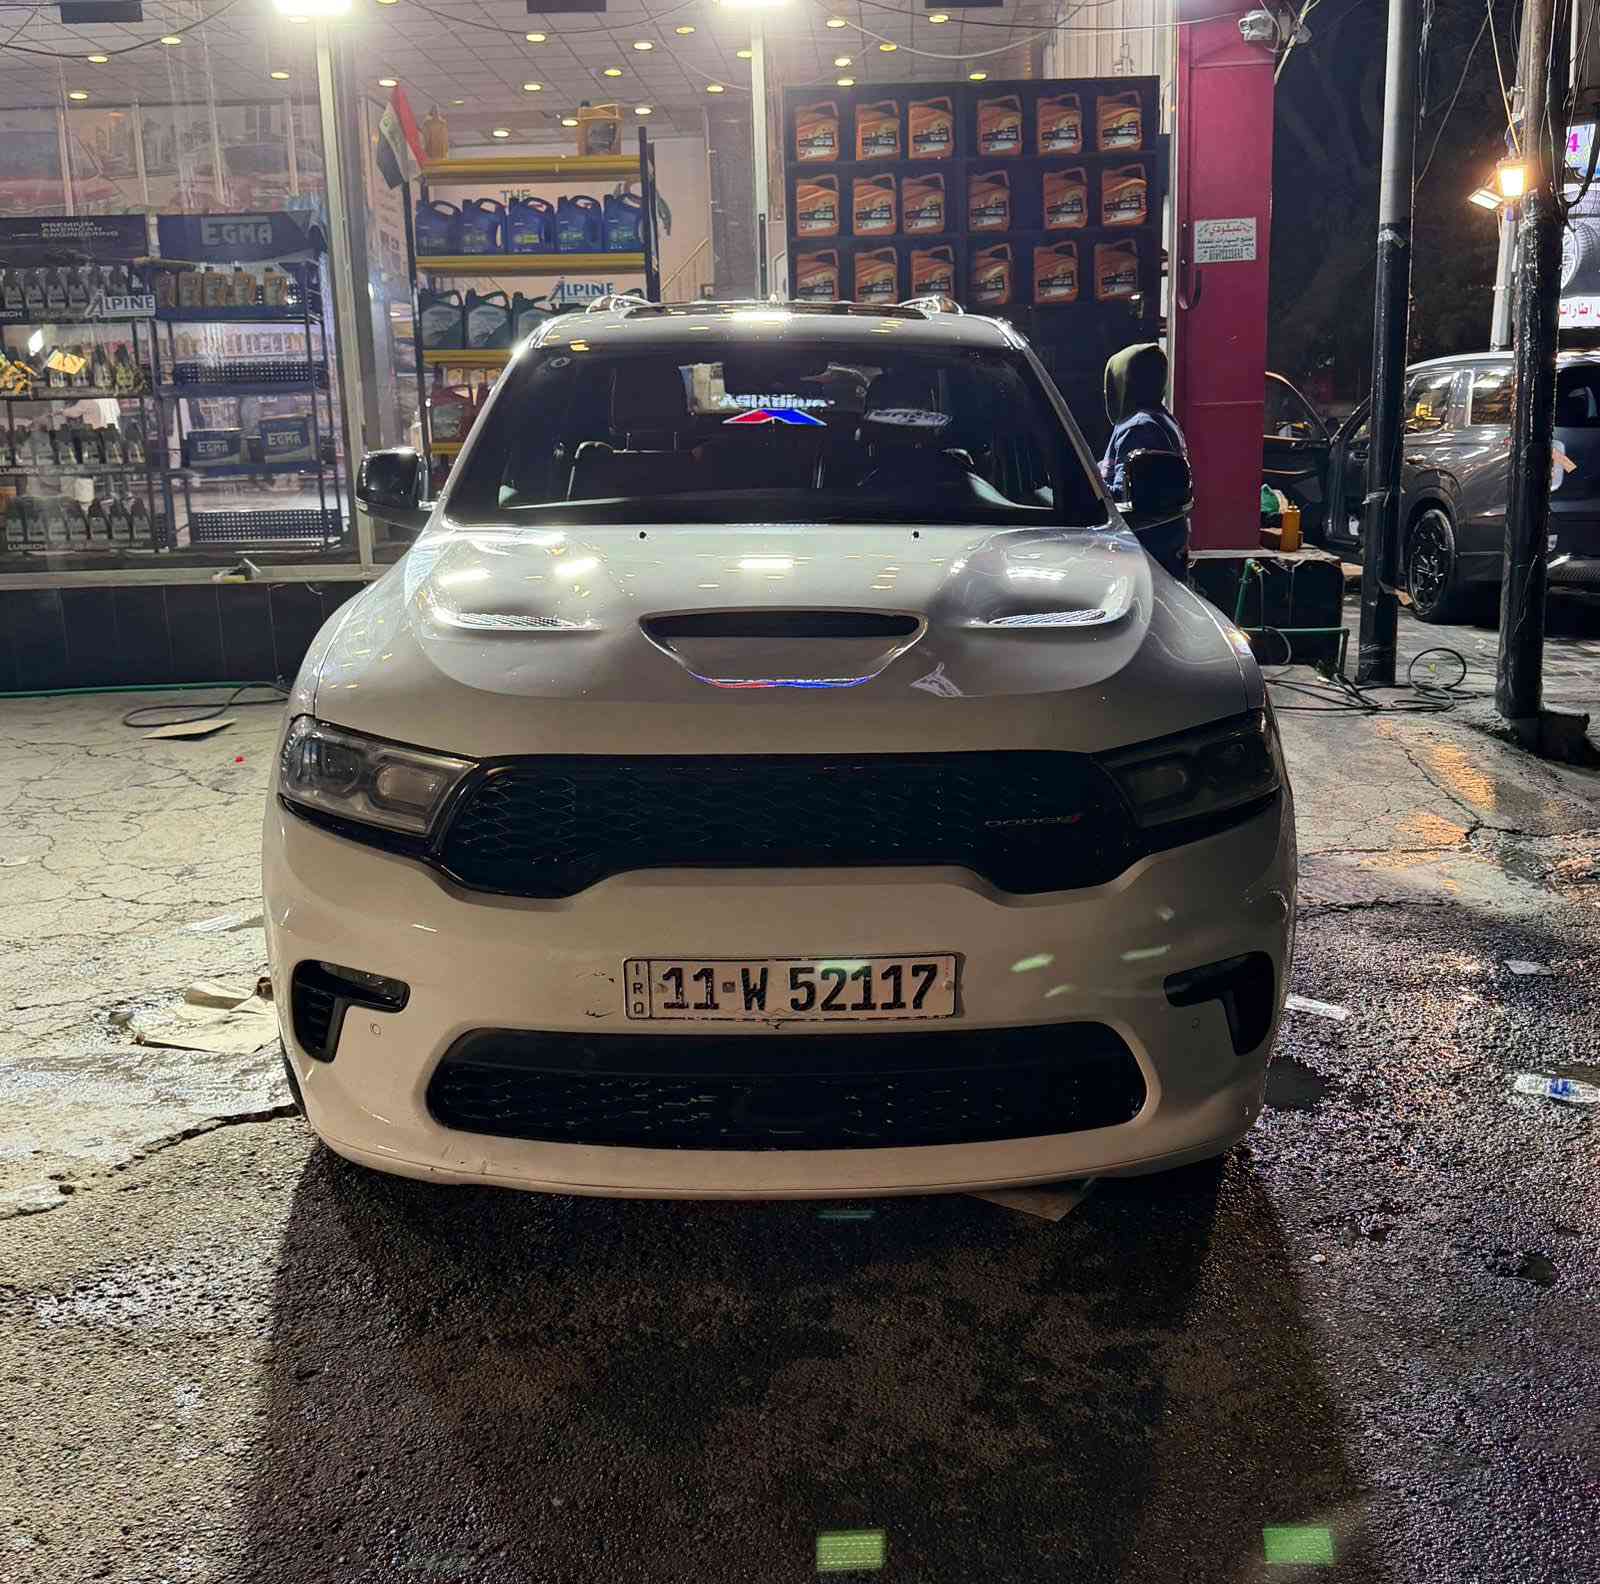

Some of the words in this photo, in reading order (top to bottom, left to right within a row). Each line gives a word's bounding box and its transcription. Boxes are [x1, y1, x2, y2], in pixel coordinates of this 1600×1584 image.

[86, 289, 155, 317] ALPINE
[548, 276, 614, 303] ALPINE
[662, 963, 719, 1010] 11
[740, 966, 769, 1011] W
[789, 963, 939, 1012] 52117
